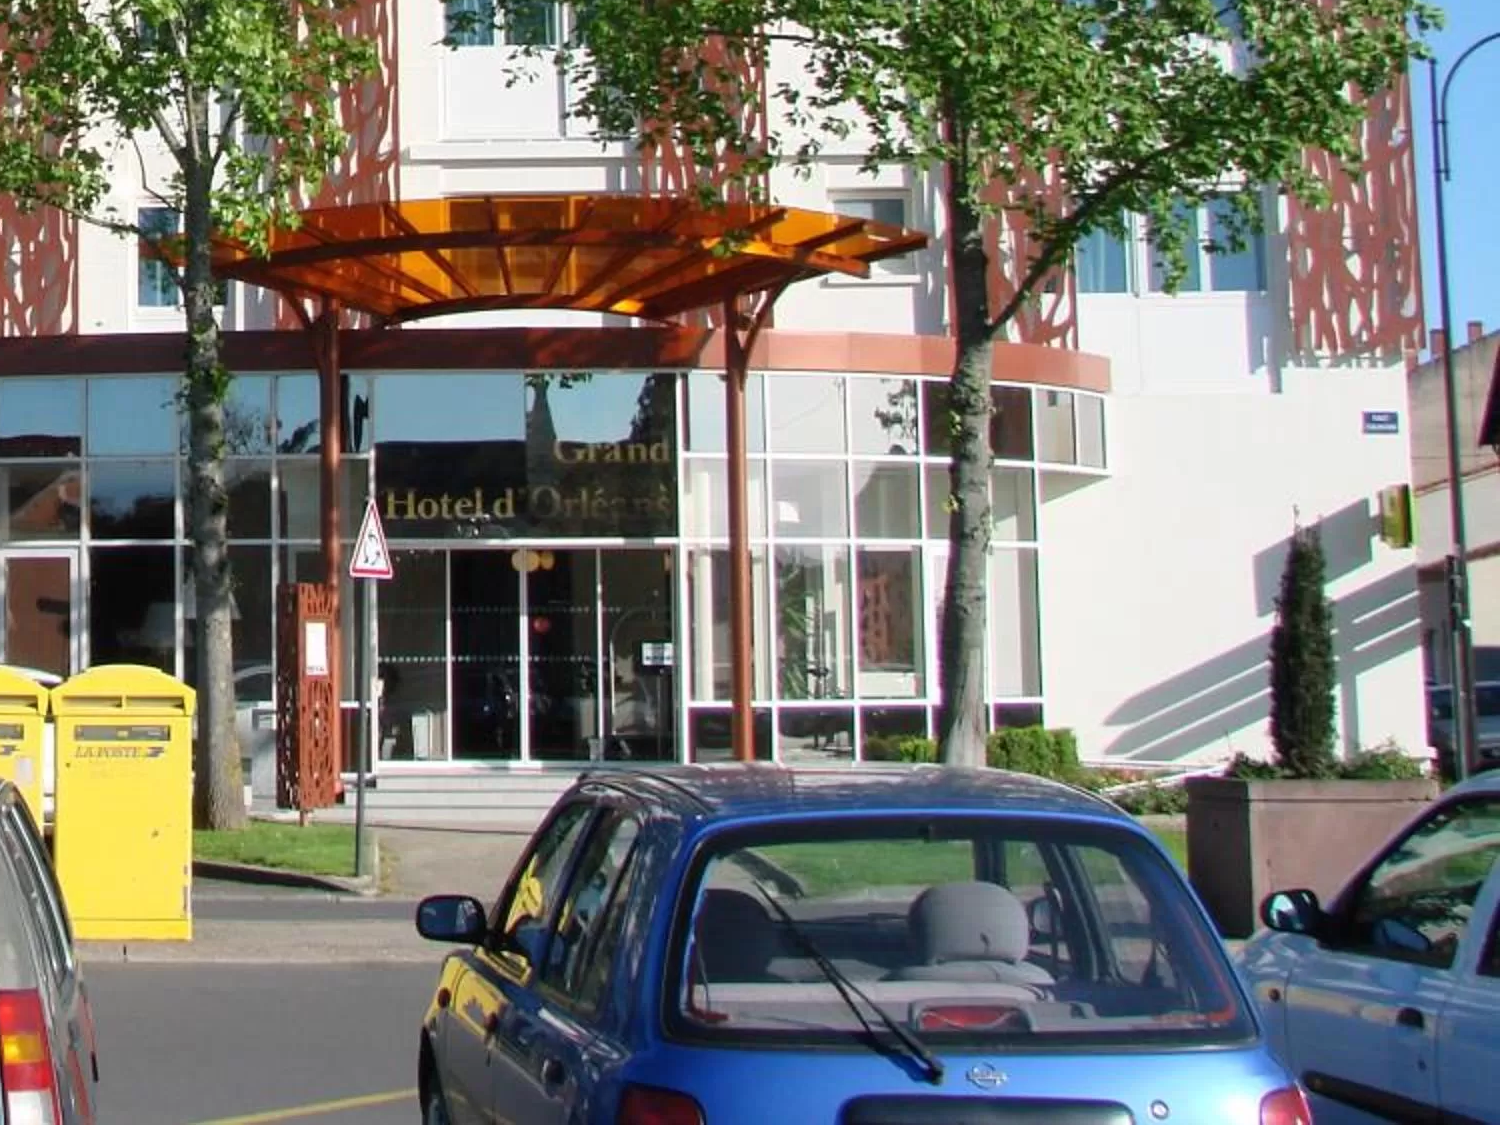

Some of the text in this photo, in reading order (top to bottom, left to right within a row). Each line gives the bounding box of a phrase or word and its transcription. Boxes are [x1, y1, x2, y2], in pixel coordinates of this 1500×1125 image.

[554, 434, 671, 464] Grand
[386, 486, 484, 520] Hotel
[75, 746, 142, 758] LA POSTE
